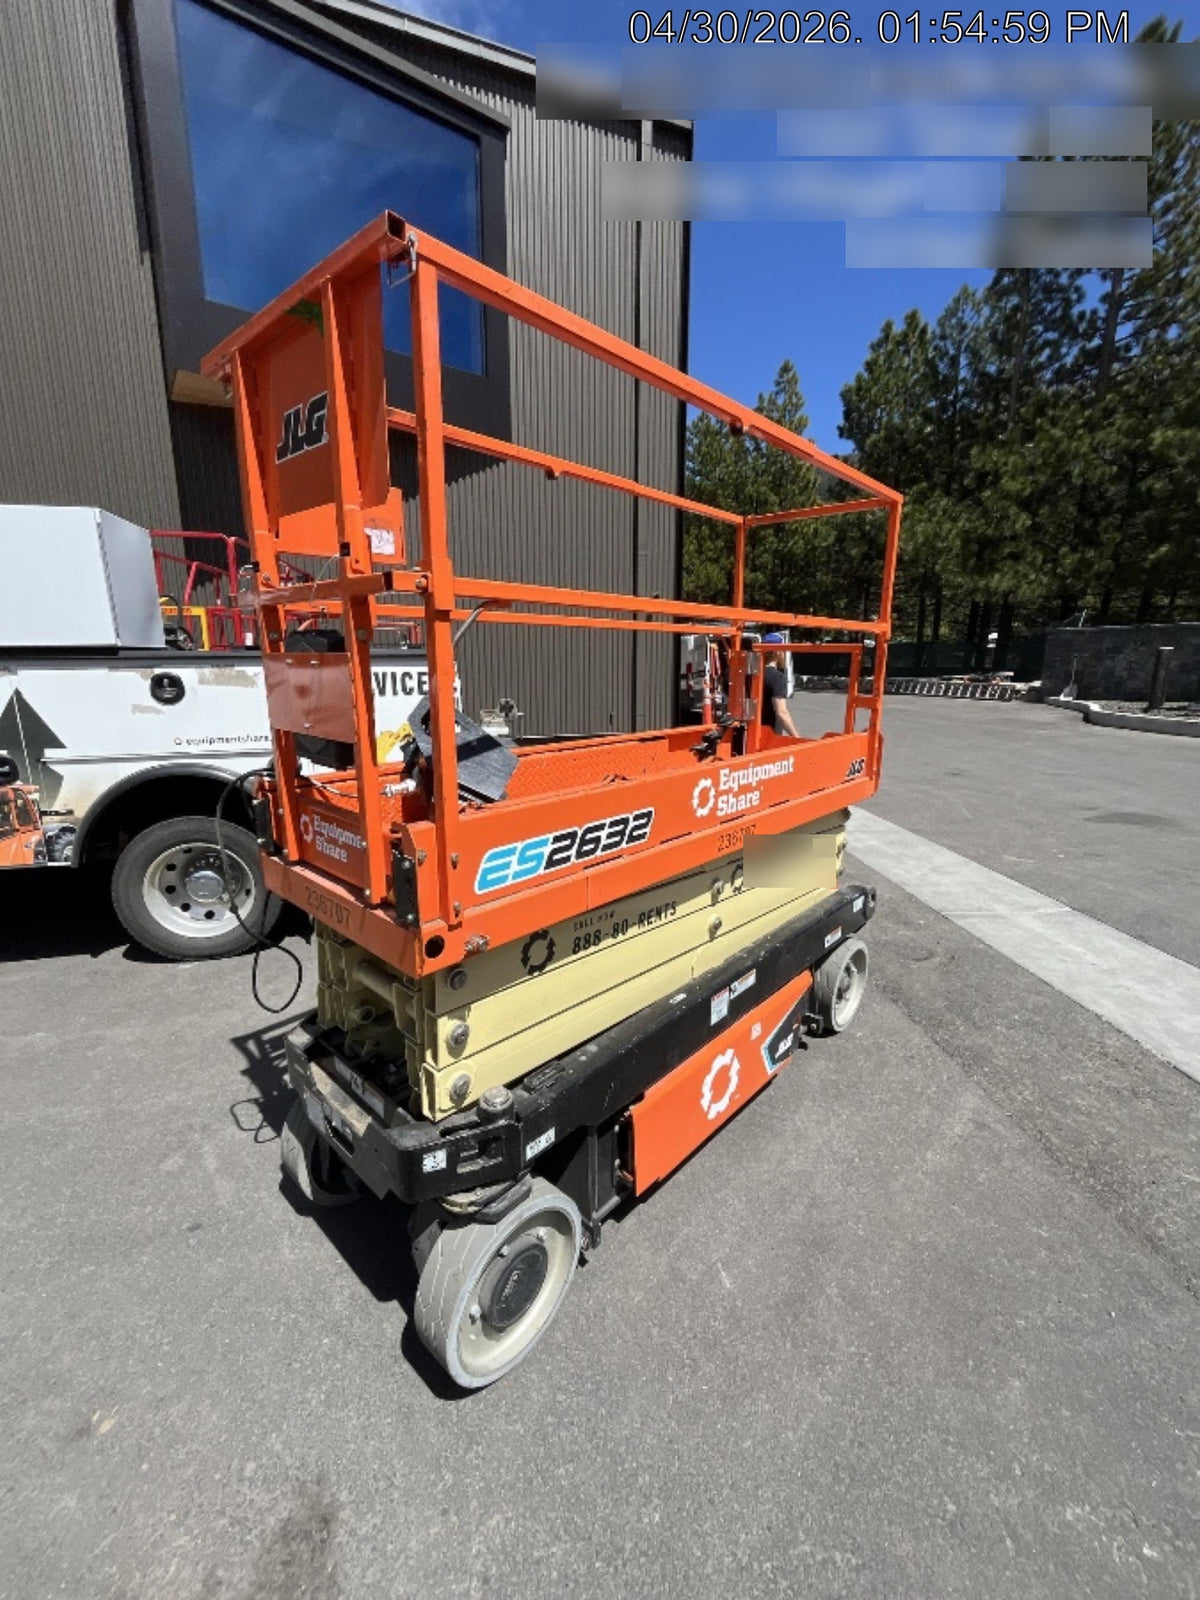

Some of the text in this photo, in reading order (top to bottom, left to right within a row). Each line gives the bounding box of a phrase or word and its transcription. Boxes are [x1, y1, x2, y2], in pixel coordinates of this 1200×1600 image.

[275, 390, 328, 464] JLG
[373, 671, 430, 696] VICE
[718, 756, 795, 792] Equipment
[716, 790, 761, 817] Share
[315, 835, 348, 863] Share
[475, 808, 654, 895] ES2632
[305, 886, 351, 928] 236707
